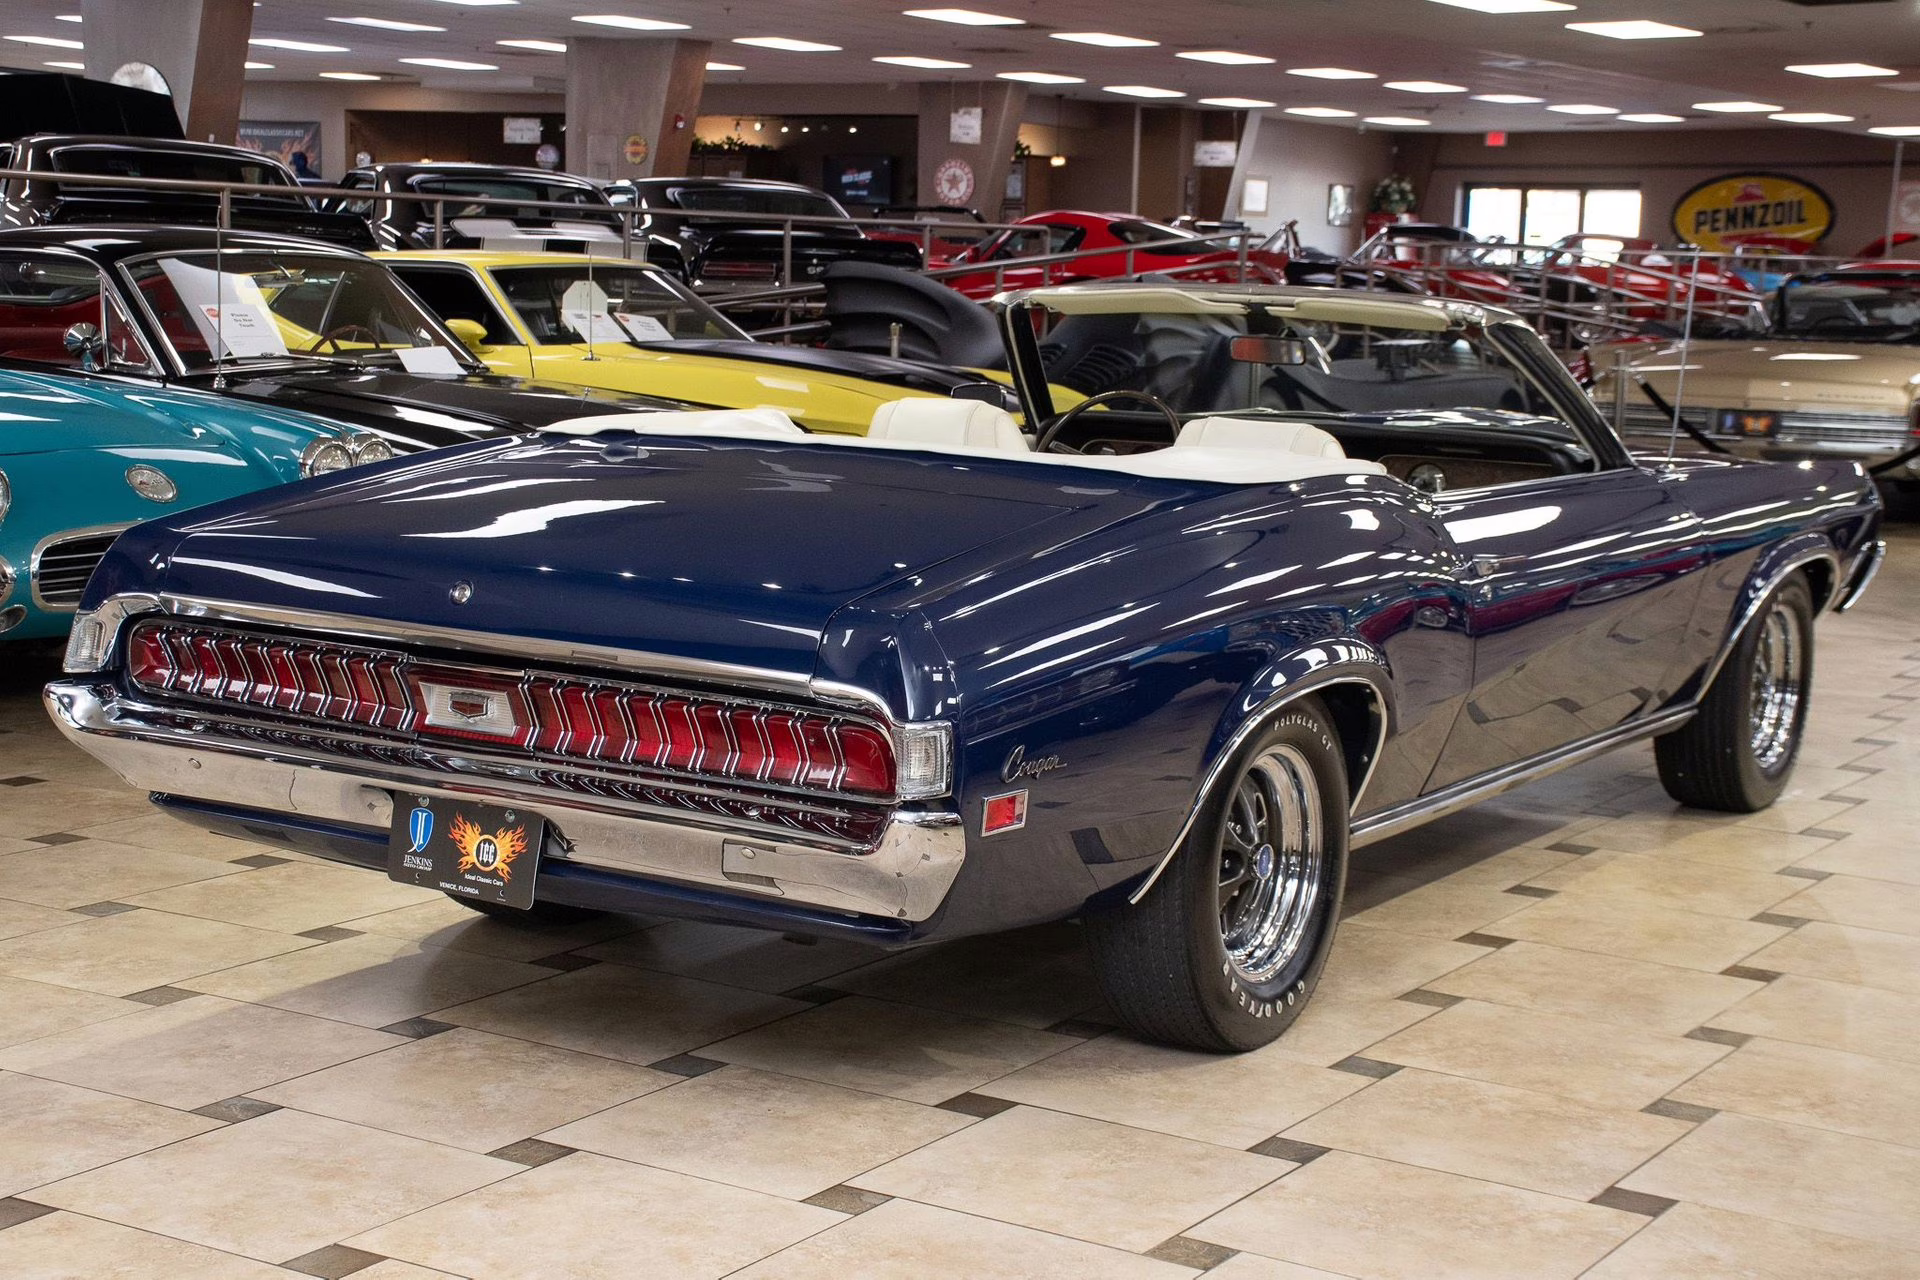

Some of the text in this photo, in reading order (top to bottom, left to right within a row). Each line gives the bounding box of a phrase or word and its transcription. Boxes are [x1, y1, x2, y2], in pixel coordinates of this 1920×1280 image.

[1694, 200, 1806, 234] PENNZOIL
[1274, 714, 1332, 751] POLYGLAS GT
[1002, 744, 1067, 783] Cougar
[403, 854, 433, 868] JENKINS
[458, 885, 480, 895] FLORIDA
[464, 873, 504, 887] Ideal Classic Cars
[1222, 959, 1305, 1018] GOODYEAR
